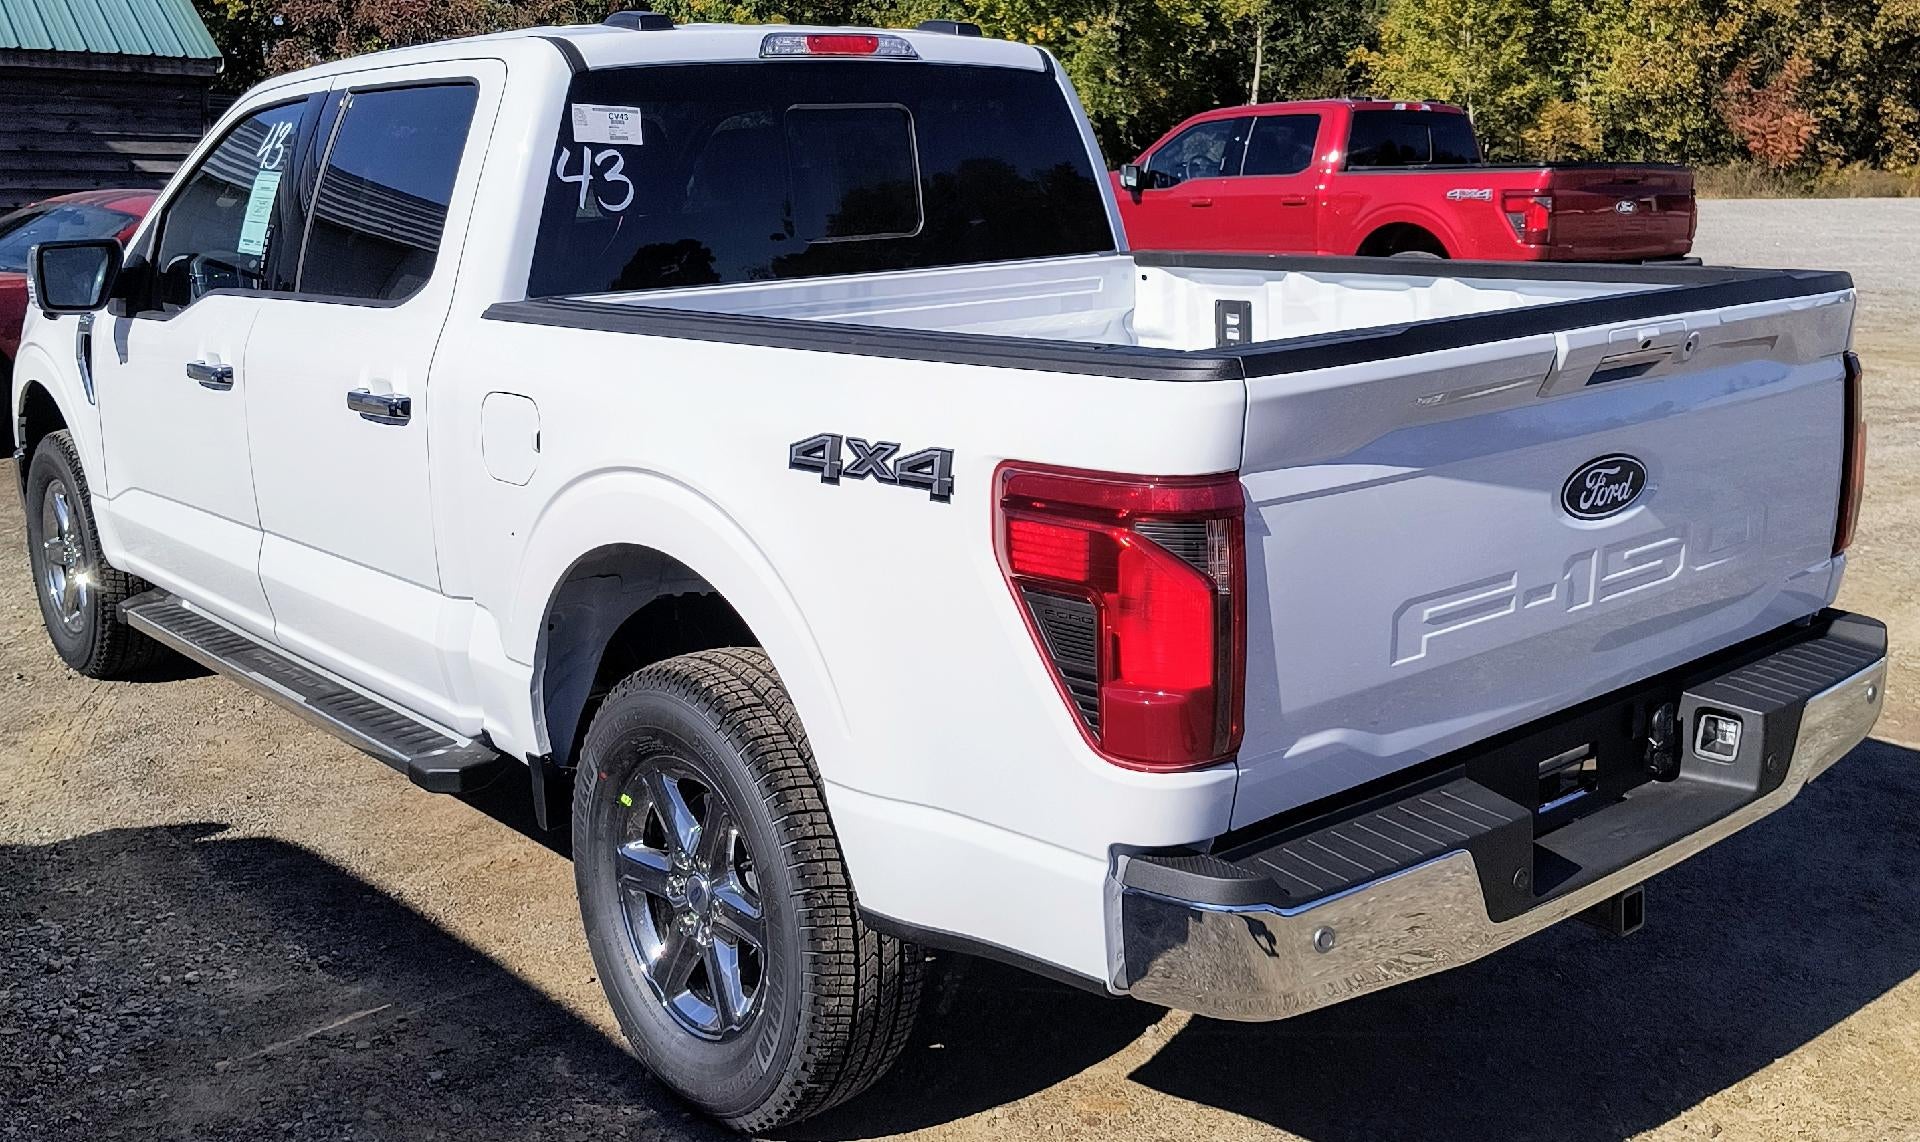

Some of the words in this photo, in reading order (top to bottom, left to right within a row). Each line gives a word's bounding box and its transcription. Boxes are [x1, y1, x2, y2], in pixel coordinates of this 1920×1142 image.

[608, 112, 629, 121] CV43
[256, 120, 293, 170] 43
[556, 145, 635, 212] 43
[1579, 465, 1634, 511] Ford
[1044, 608, 1094, 625] FORD
